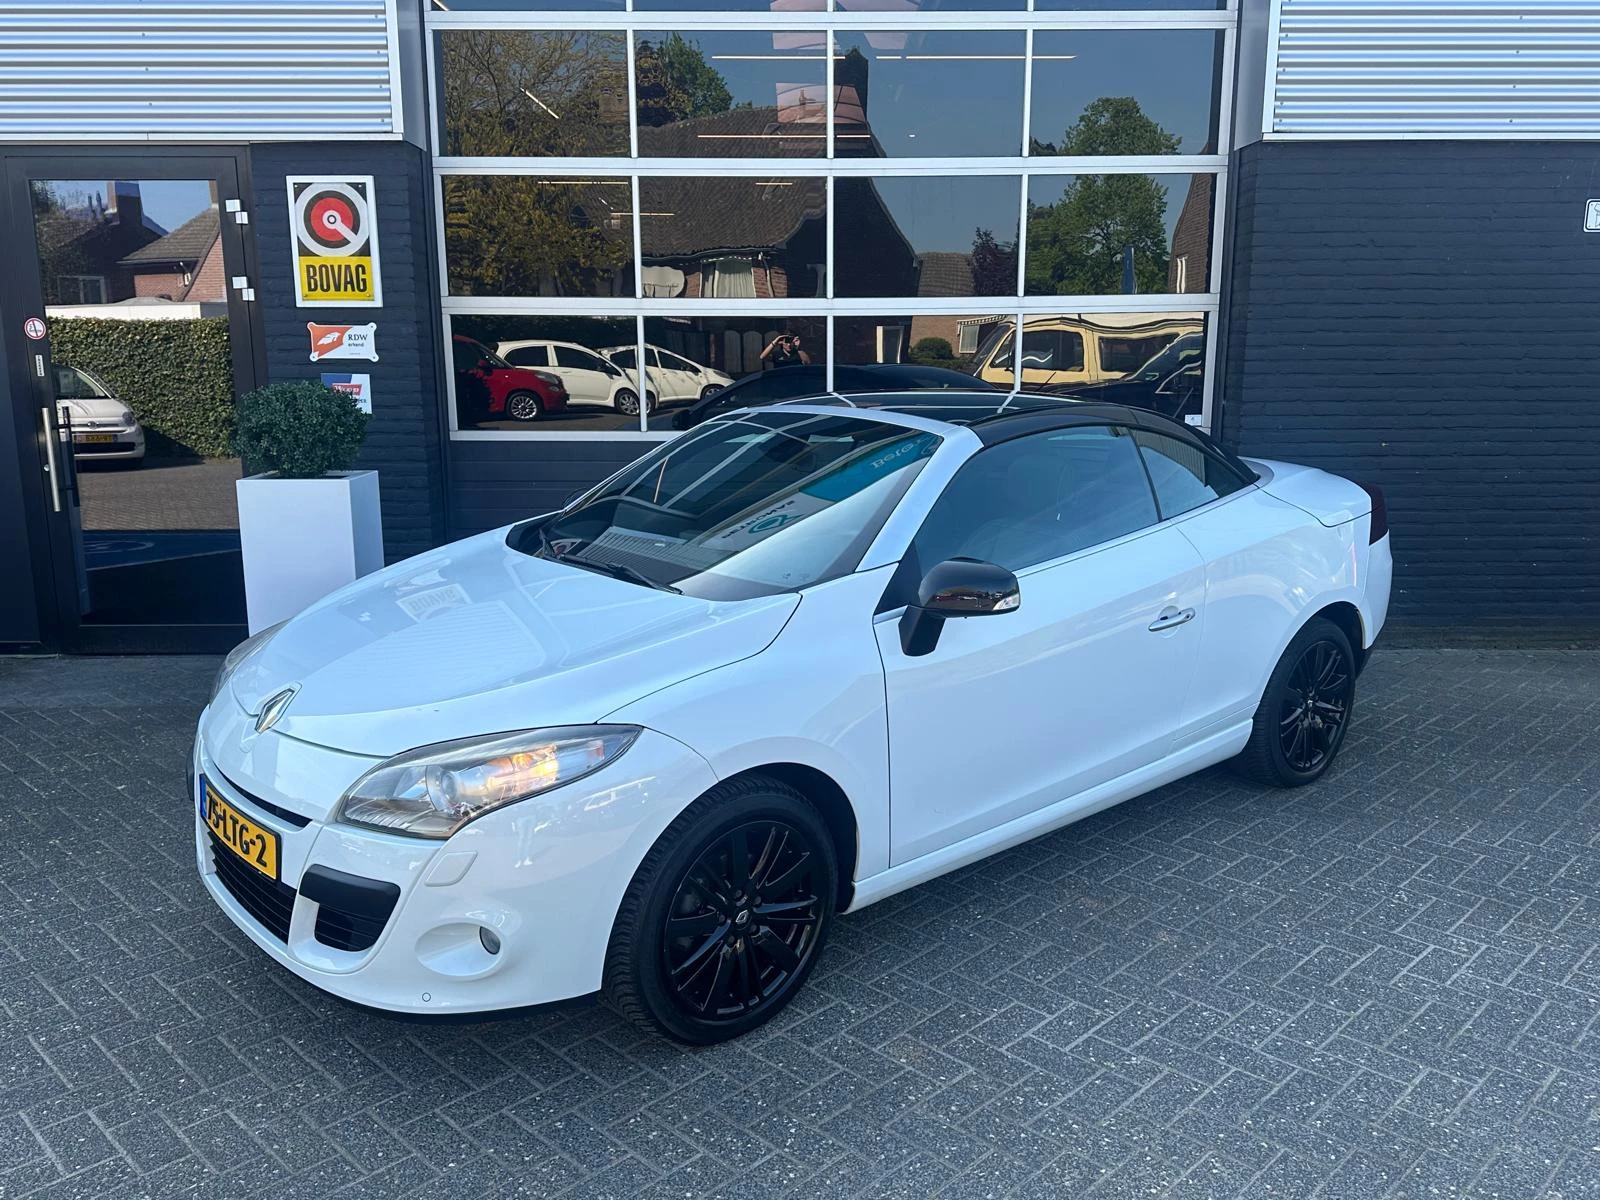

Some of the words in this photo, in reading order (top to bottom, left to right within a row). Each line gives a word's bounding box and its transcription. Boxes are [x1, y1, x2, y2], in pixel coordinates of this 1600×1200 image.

[306, 263, 368, 293] BOVAG
[348, 333, 368, 341] RDW
[206, 790, 268, 868] 75-LTG-2
